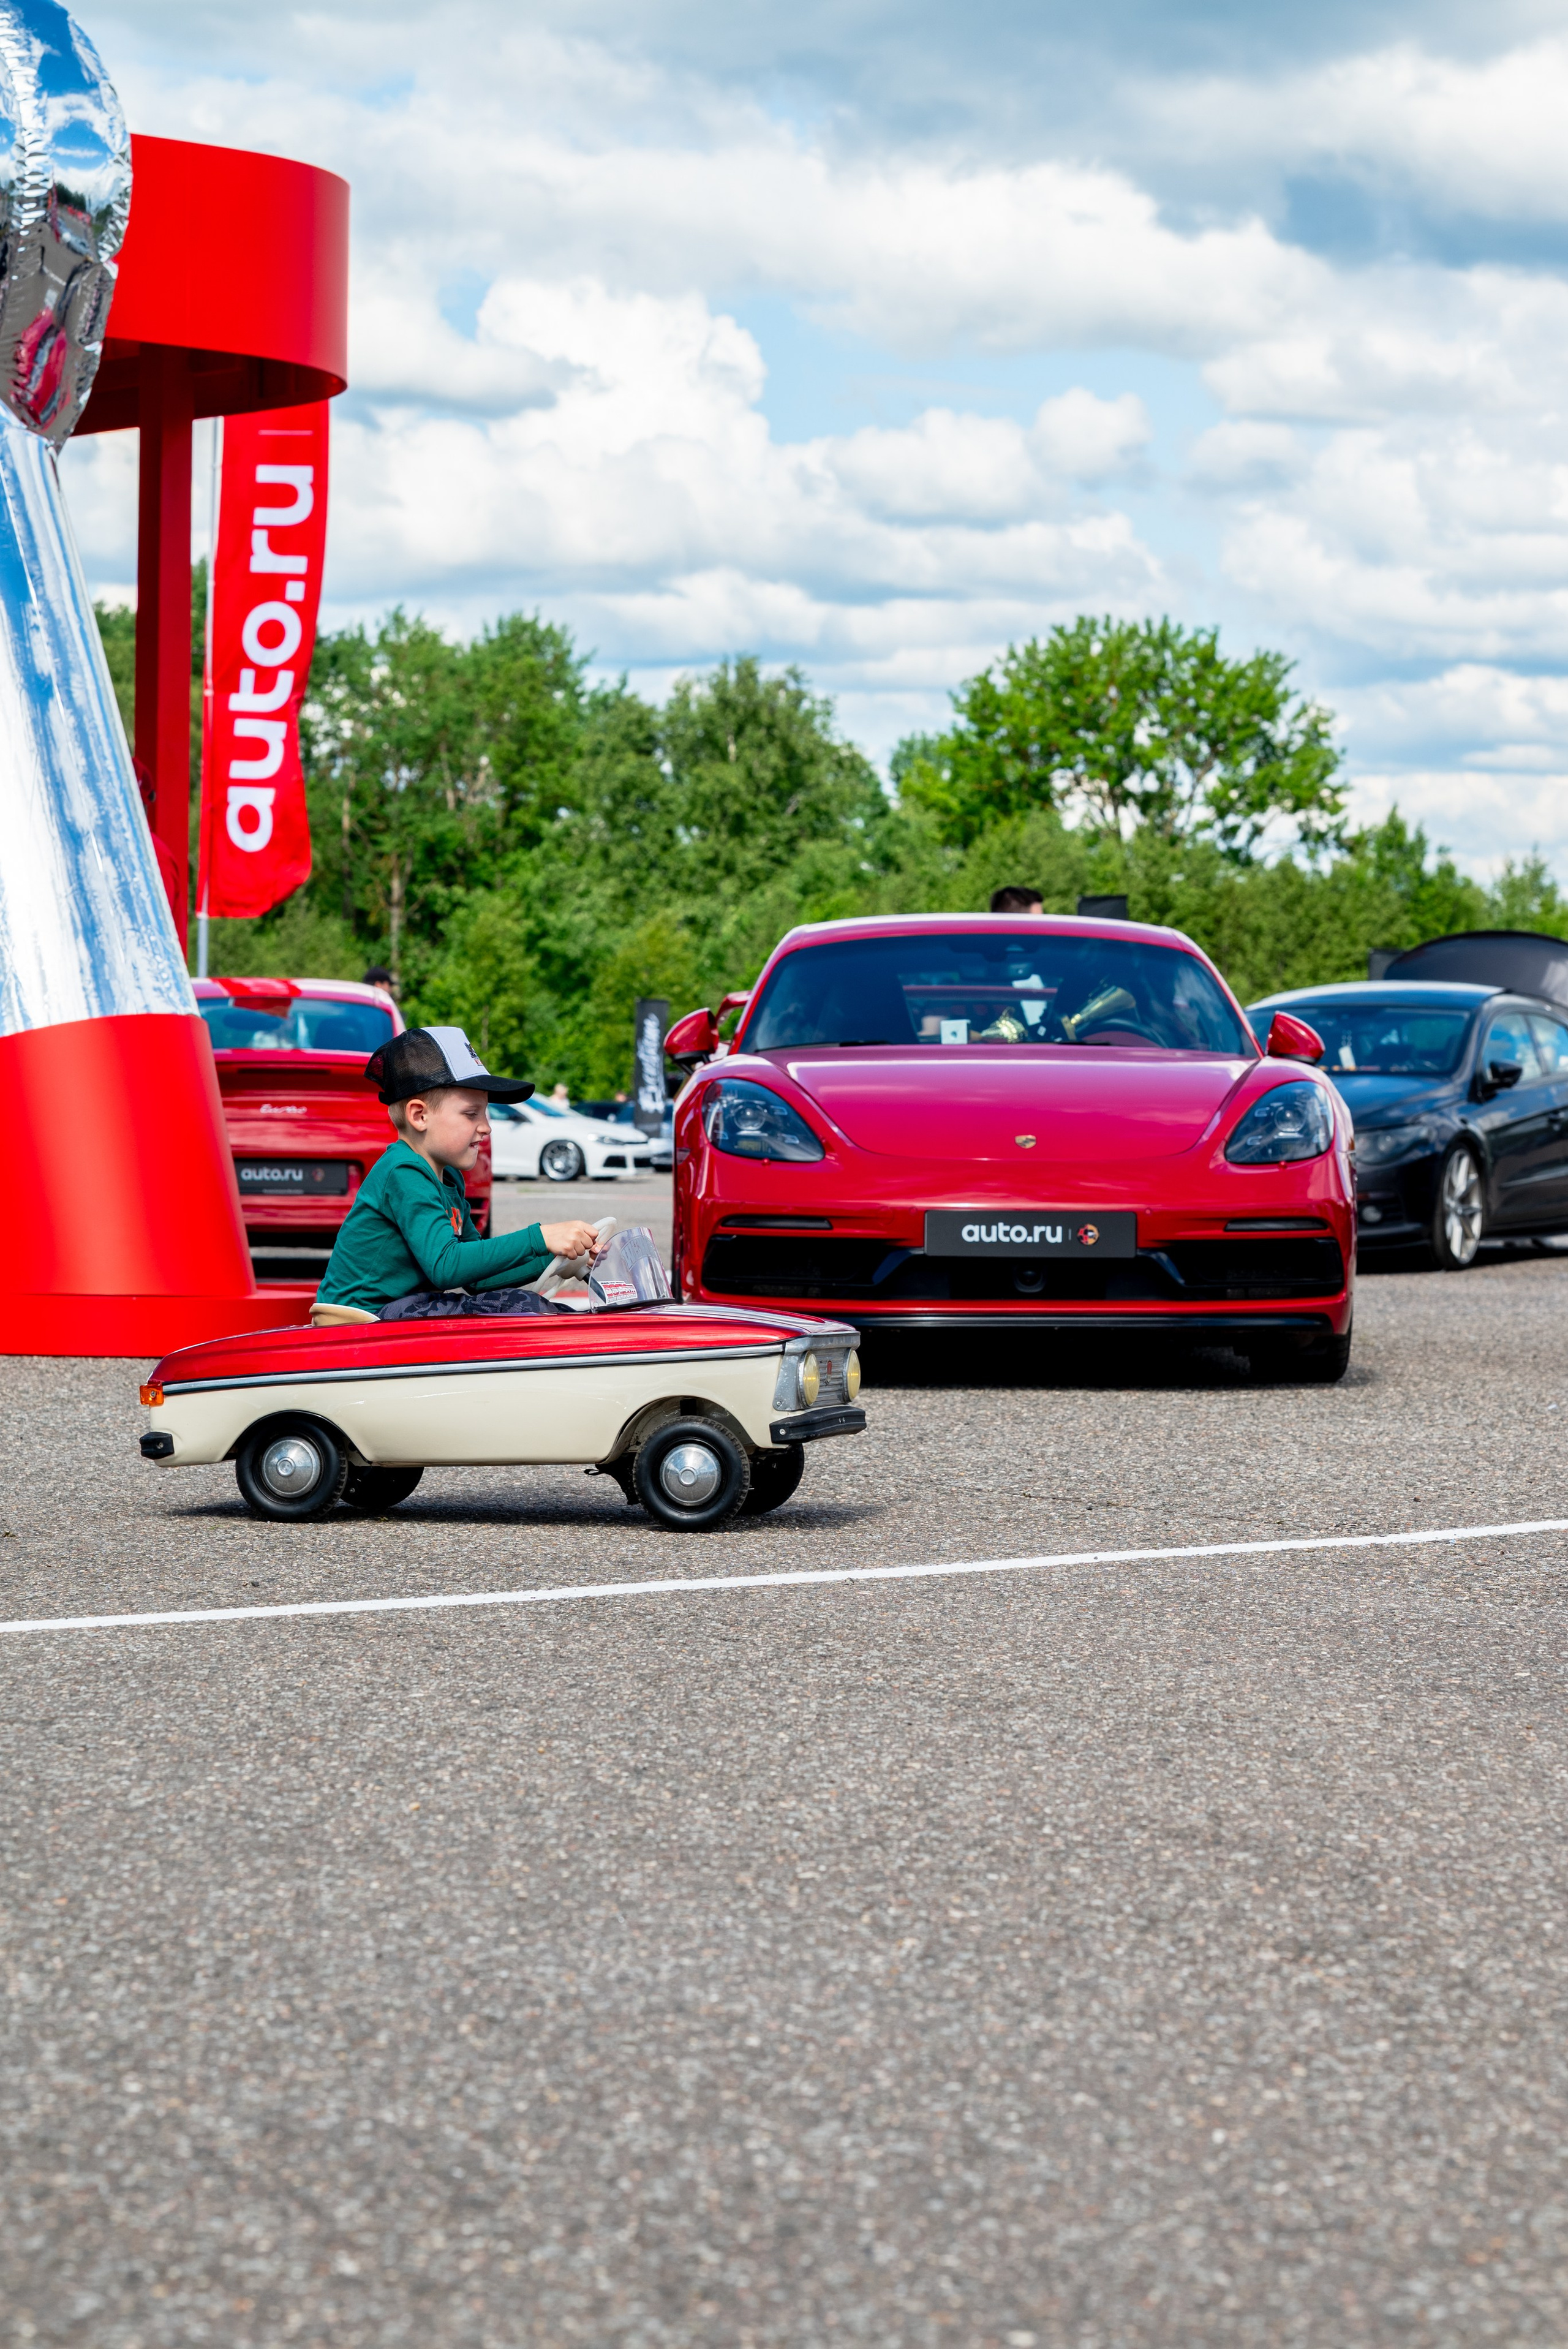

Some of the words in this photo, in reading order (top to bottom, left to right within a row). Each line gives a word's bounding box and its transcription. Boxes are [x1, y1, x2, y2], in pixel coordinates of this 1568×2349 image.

[225, 464, 314, 853] auto.ru
[241, 1167, 303, 1181] auto.ru
[961, 1222, 1063, 1243] auto.ru
